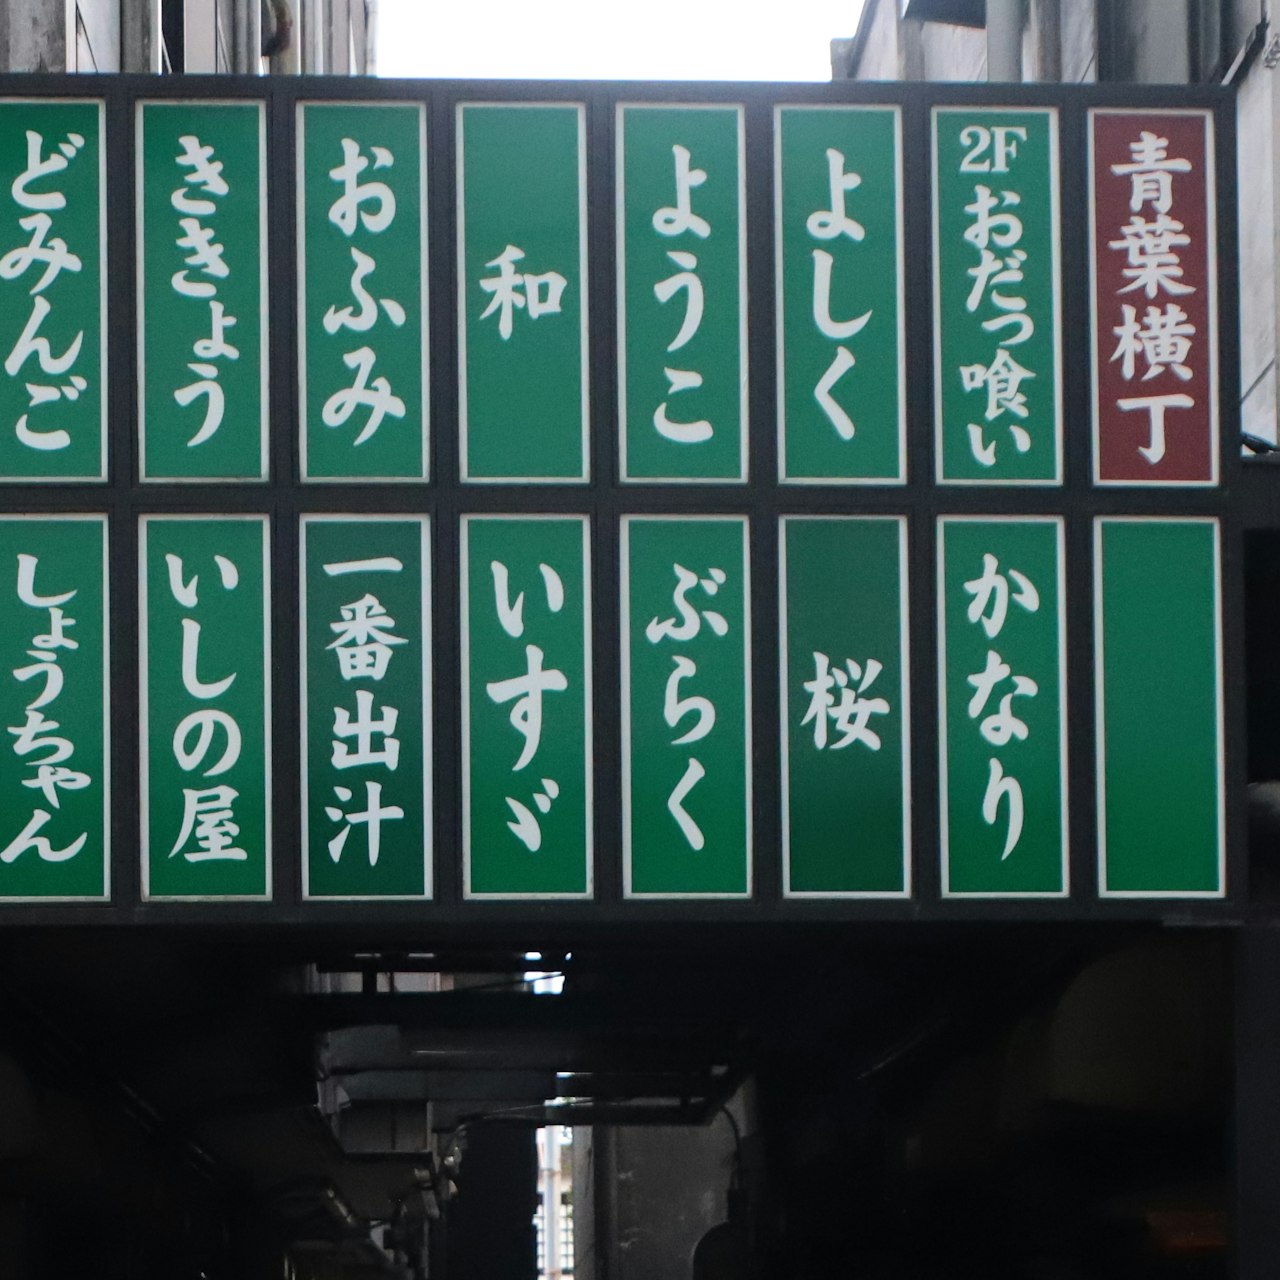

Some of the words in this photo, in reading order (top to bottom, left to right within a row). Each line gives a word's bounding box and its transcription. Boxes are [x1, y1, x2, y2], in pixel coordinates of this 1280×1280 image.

[171, 135, 240, 447] ききょう
[322, 138, 406, 445] おふみ
[479, 244, 568, 339] 和
[652, 144, 714, 443] ようこ
[806, 148, 873, 440] よしく
[959, 125, 1027, 172] 2F
[1109, 131, 1196, 464] 青葉横丁
[0, 553, 91, 863] しょうちゃん
[165, 553, 247, 862] いしの屋
[323, 557, 408, 866] 一番出汁
[645, 563, 728, 850] ぶらく
[801, 652, 890, 750] 桜
[964, 553, 1040, 860] かなり
